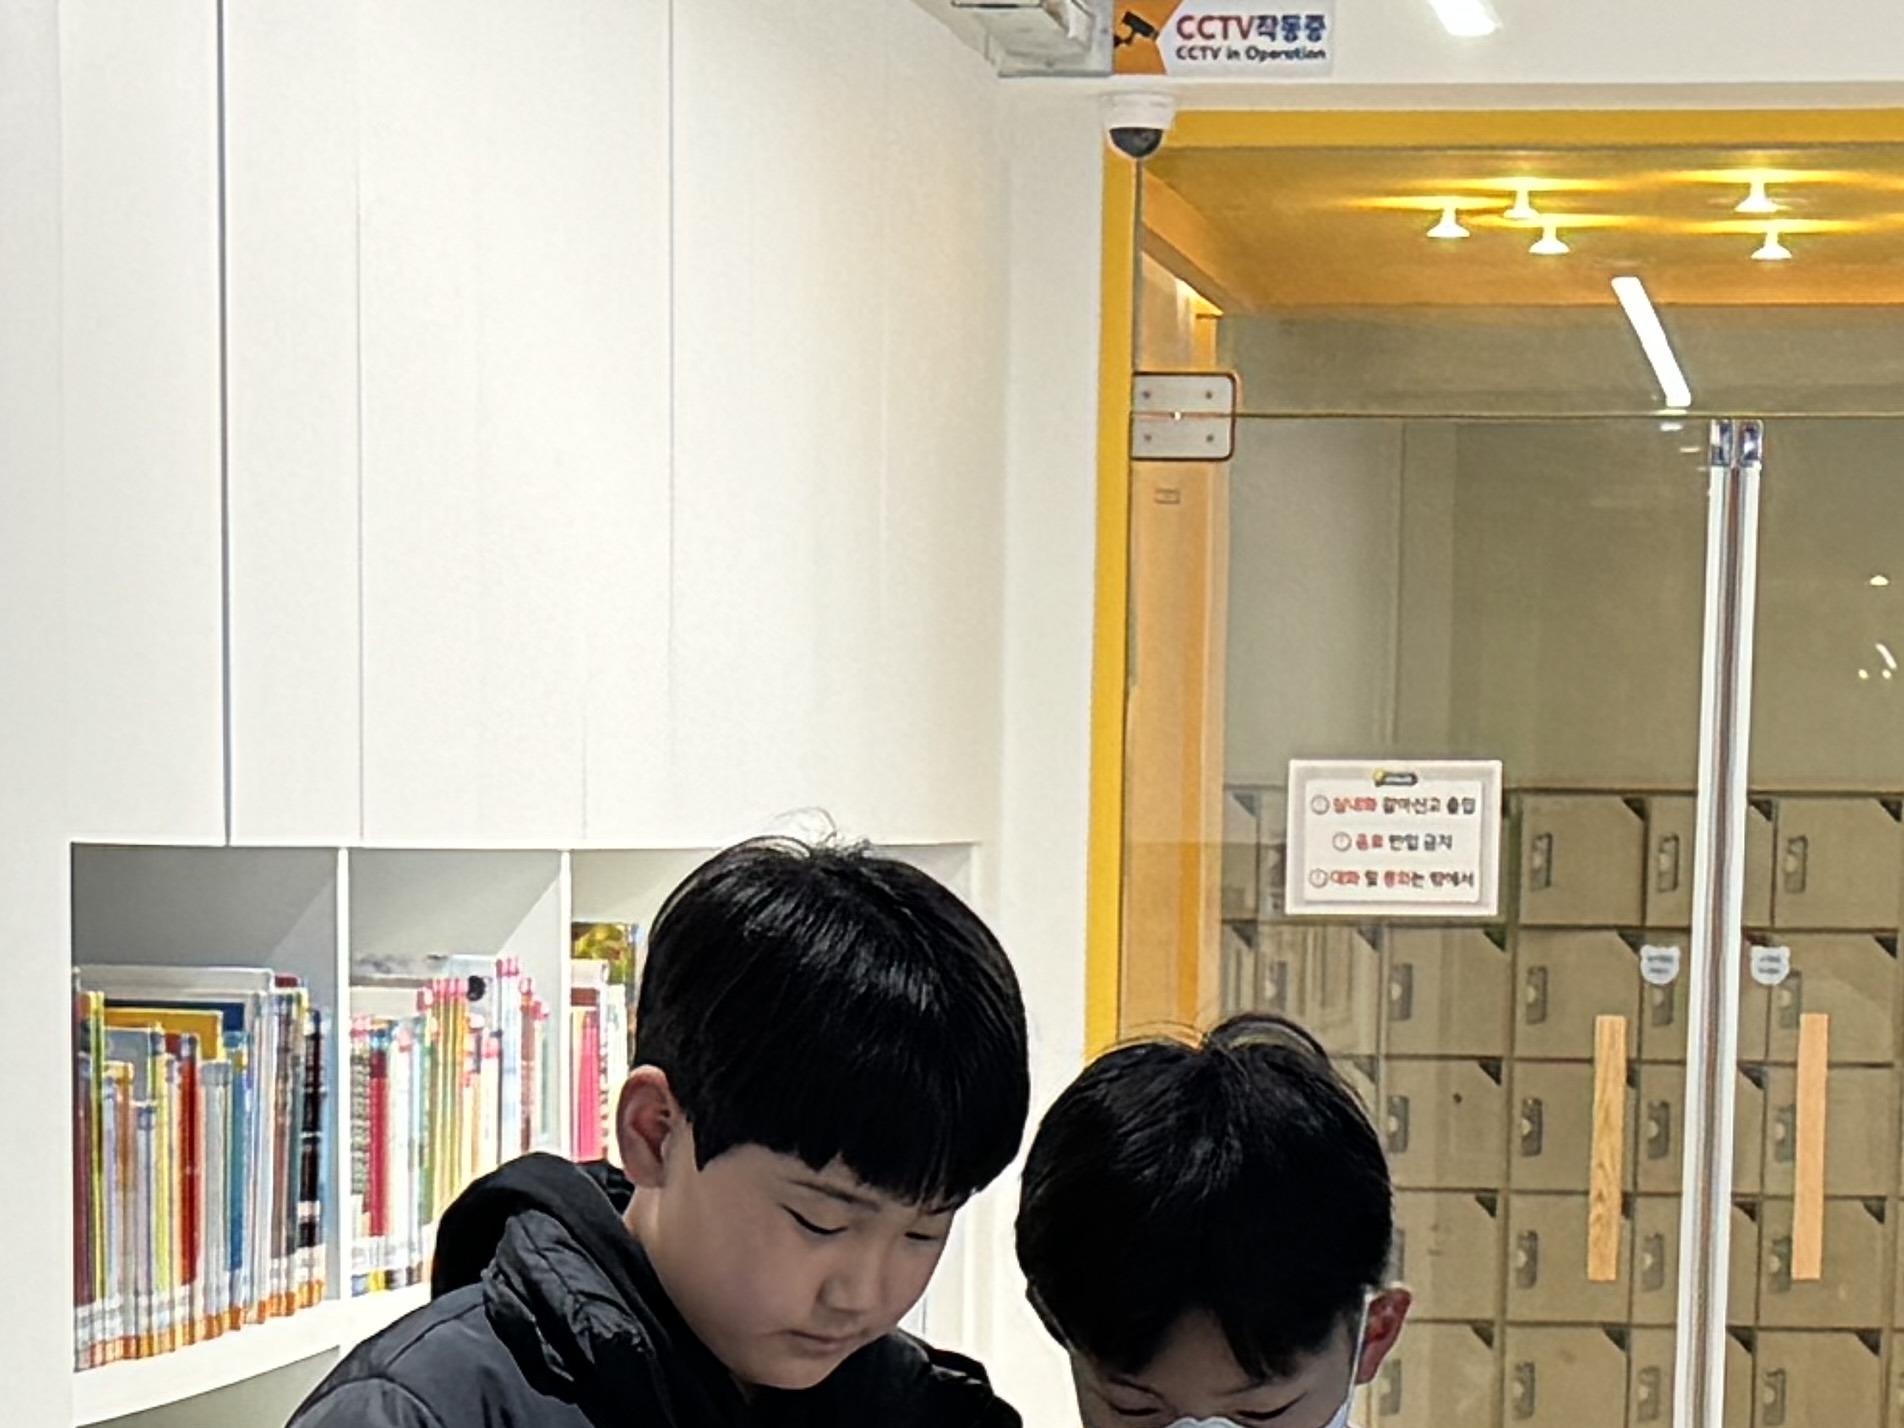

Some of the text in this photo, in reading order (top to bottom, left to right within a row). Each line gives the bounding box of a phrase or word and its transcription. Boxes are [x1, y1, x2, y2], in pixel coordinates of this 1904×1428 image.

[1176, 14, 1326, 43] CCTV작동중
[1176, 46, 1326, 63] CCTV in Operation
[1424, 833, 1452, 851] 금지
